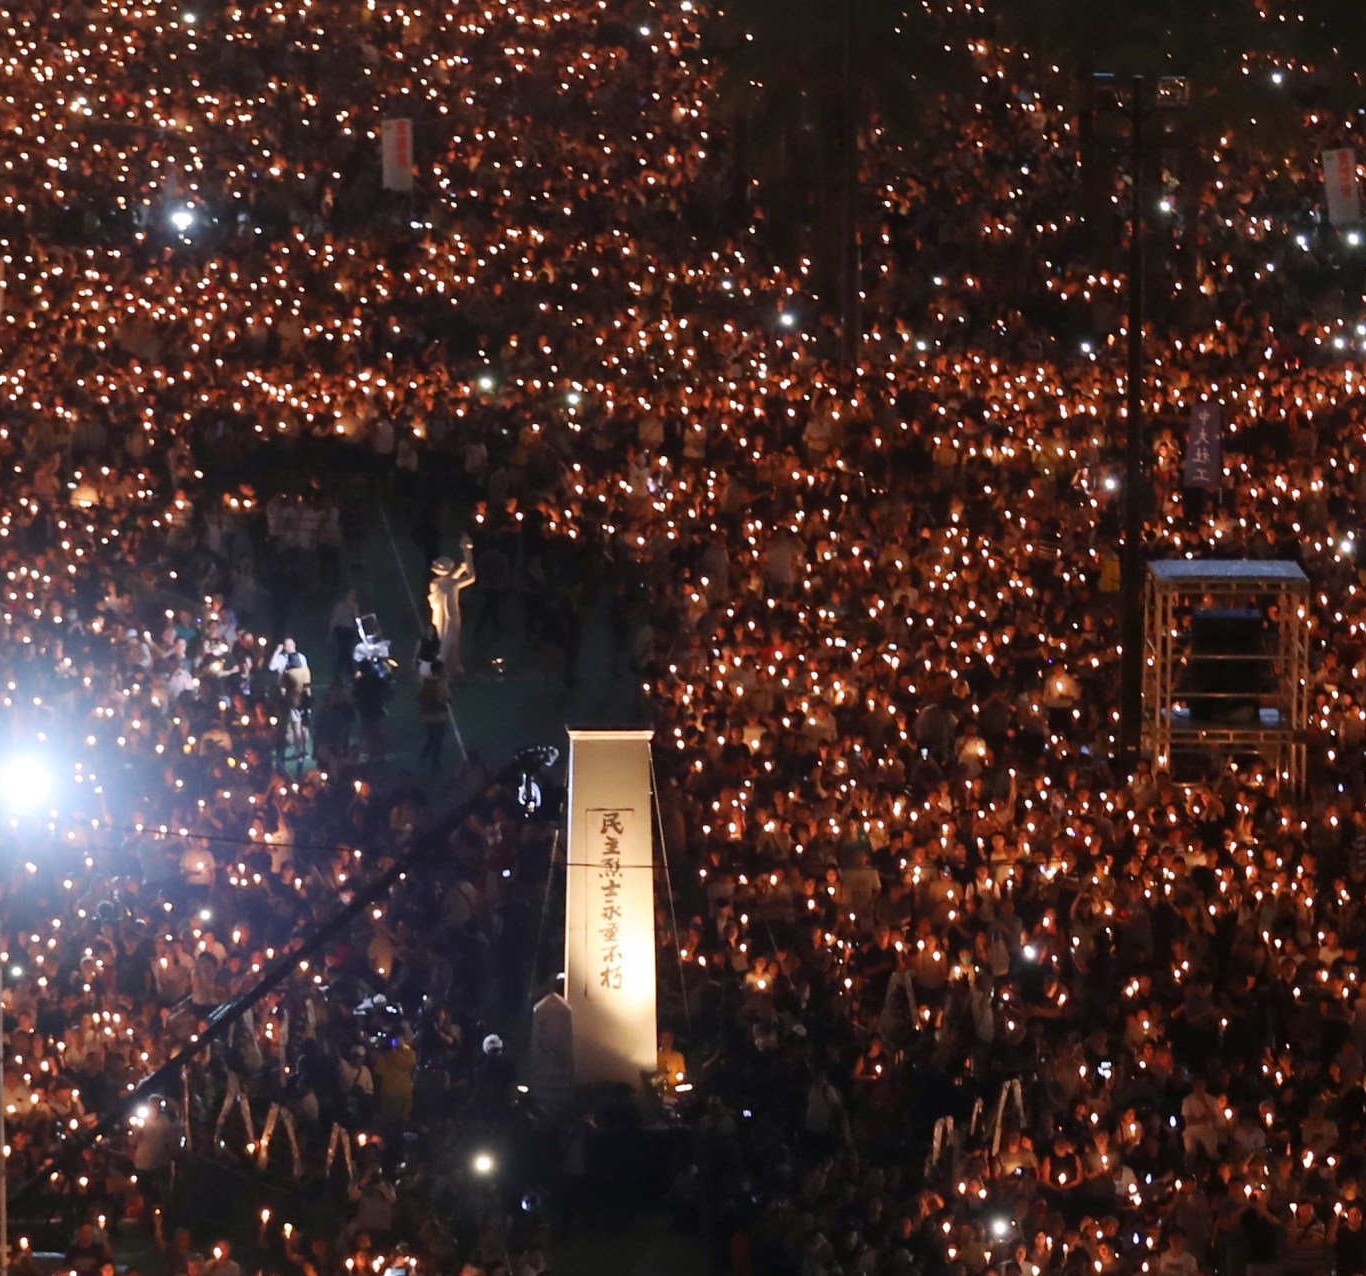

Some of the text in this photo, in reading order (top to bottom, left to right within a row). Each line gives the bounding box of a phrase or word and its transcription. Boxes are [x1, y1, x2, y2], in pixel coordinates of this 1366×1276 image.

[599, 812, 624, 990] 民主烈士永垂不朽
